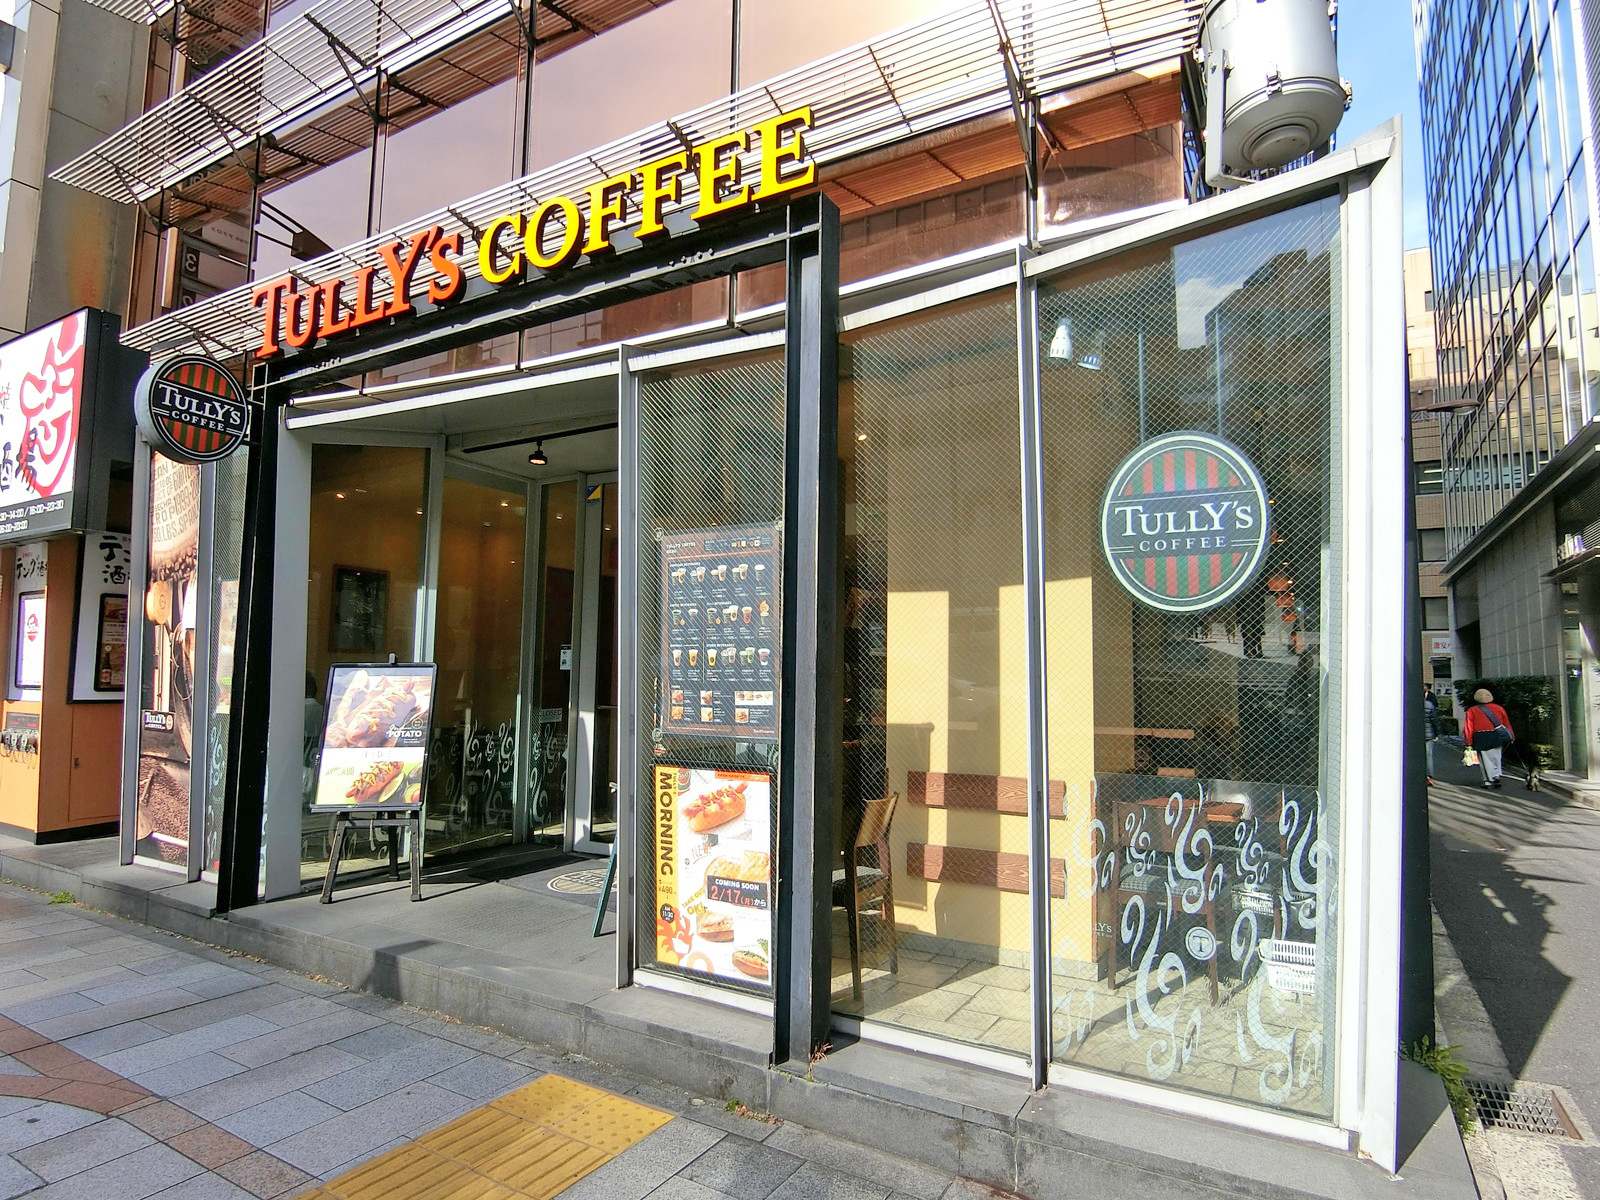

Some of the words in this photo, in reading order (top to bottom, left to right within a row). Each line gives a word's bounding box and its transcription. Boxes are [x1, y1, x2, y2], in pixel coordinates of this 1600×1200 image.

[253, 225, 465, 358] TULLY'S
[478, 105, 818, 285] COFFEE
[158, 383, 242, 426] TULLY'S
[171, 409, 226, 432] COFFEE
[1114, 501, 1254, 536] TULLY'S
[1139, 536, 1226, 552] COFFEE
[388, 730, 422, 738] POTATO
[659, 771, 674, 876] MORNING
[715, 878, 741, 888] COMING
[741, 882, 760, 891] SOON
